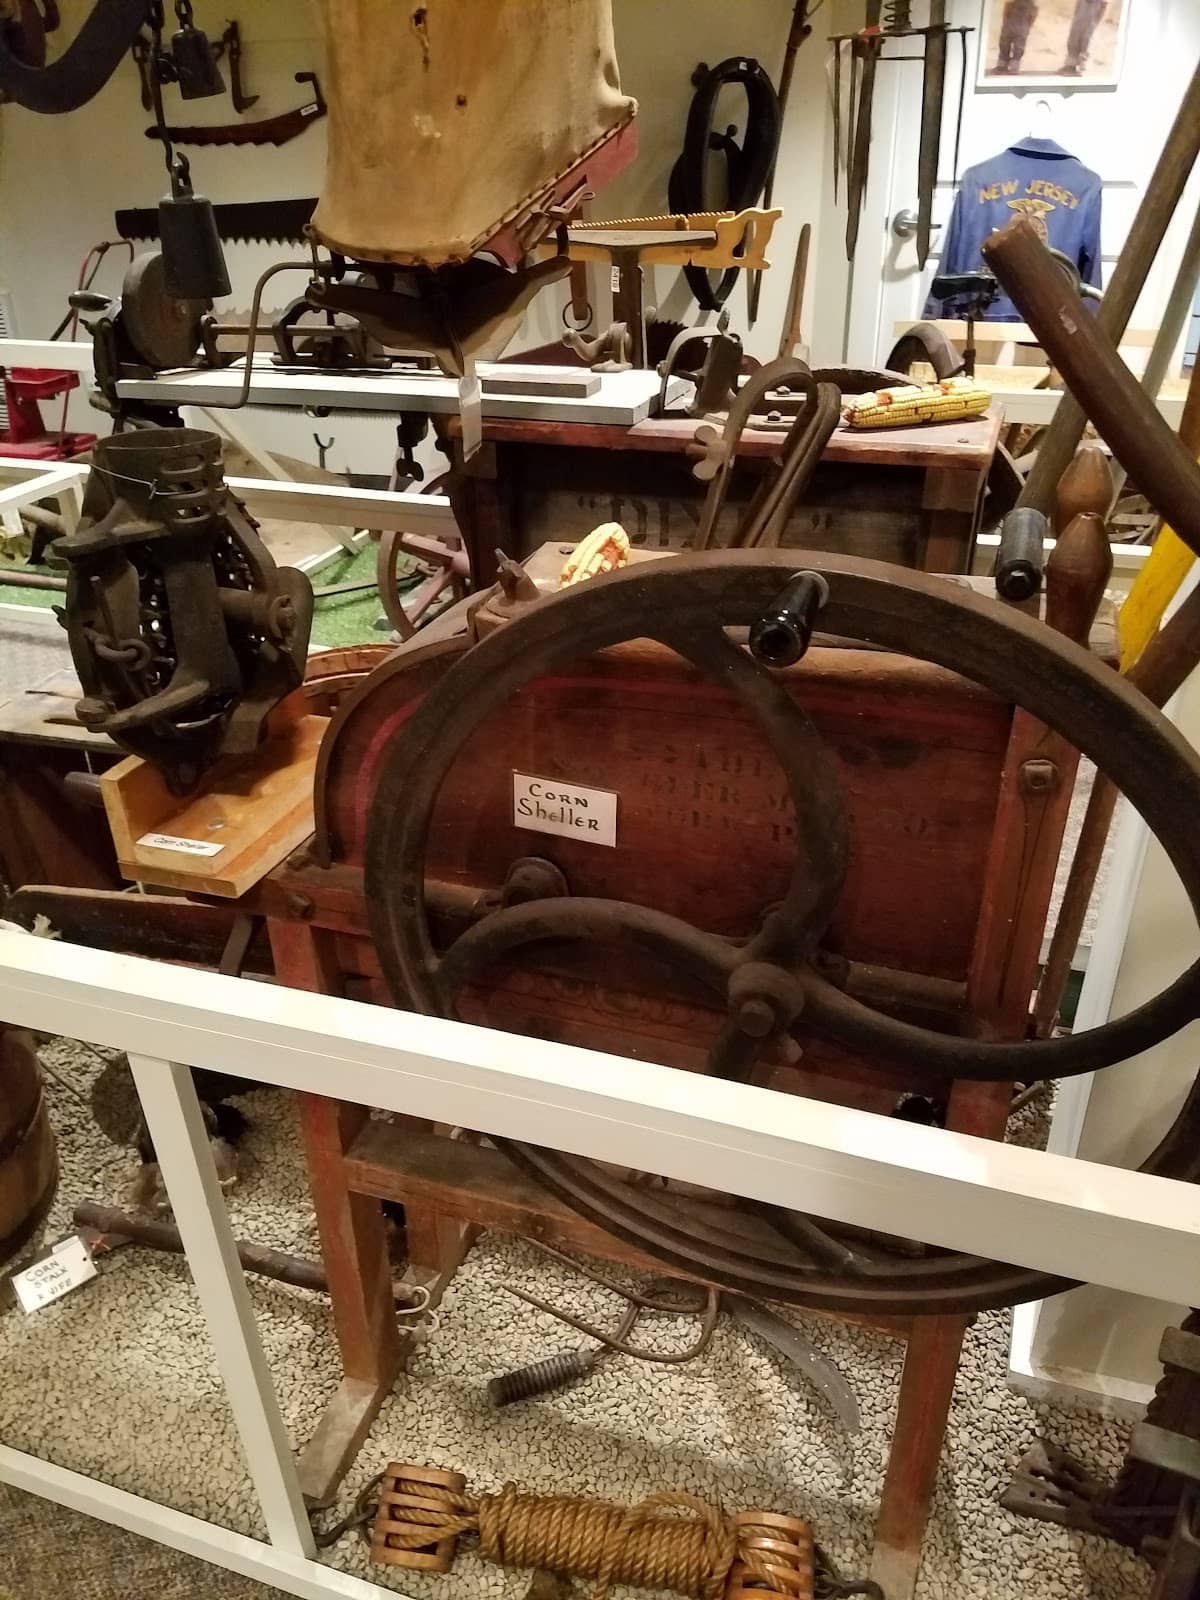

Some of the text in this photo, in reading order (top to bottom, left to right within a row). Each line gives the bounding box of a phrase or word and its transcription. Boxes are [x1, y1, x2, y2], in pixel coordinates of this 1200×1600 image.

[979, 179, 1080, 210] NEW JERSEY
[529, 783, 589, 808] CORN
[25, 1260, 60, 1282] CORN
[34, 1265, 69, 1288] STALK
